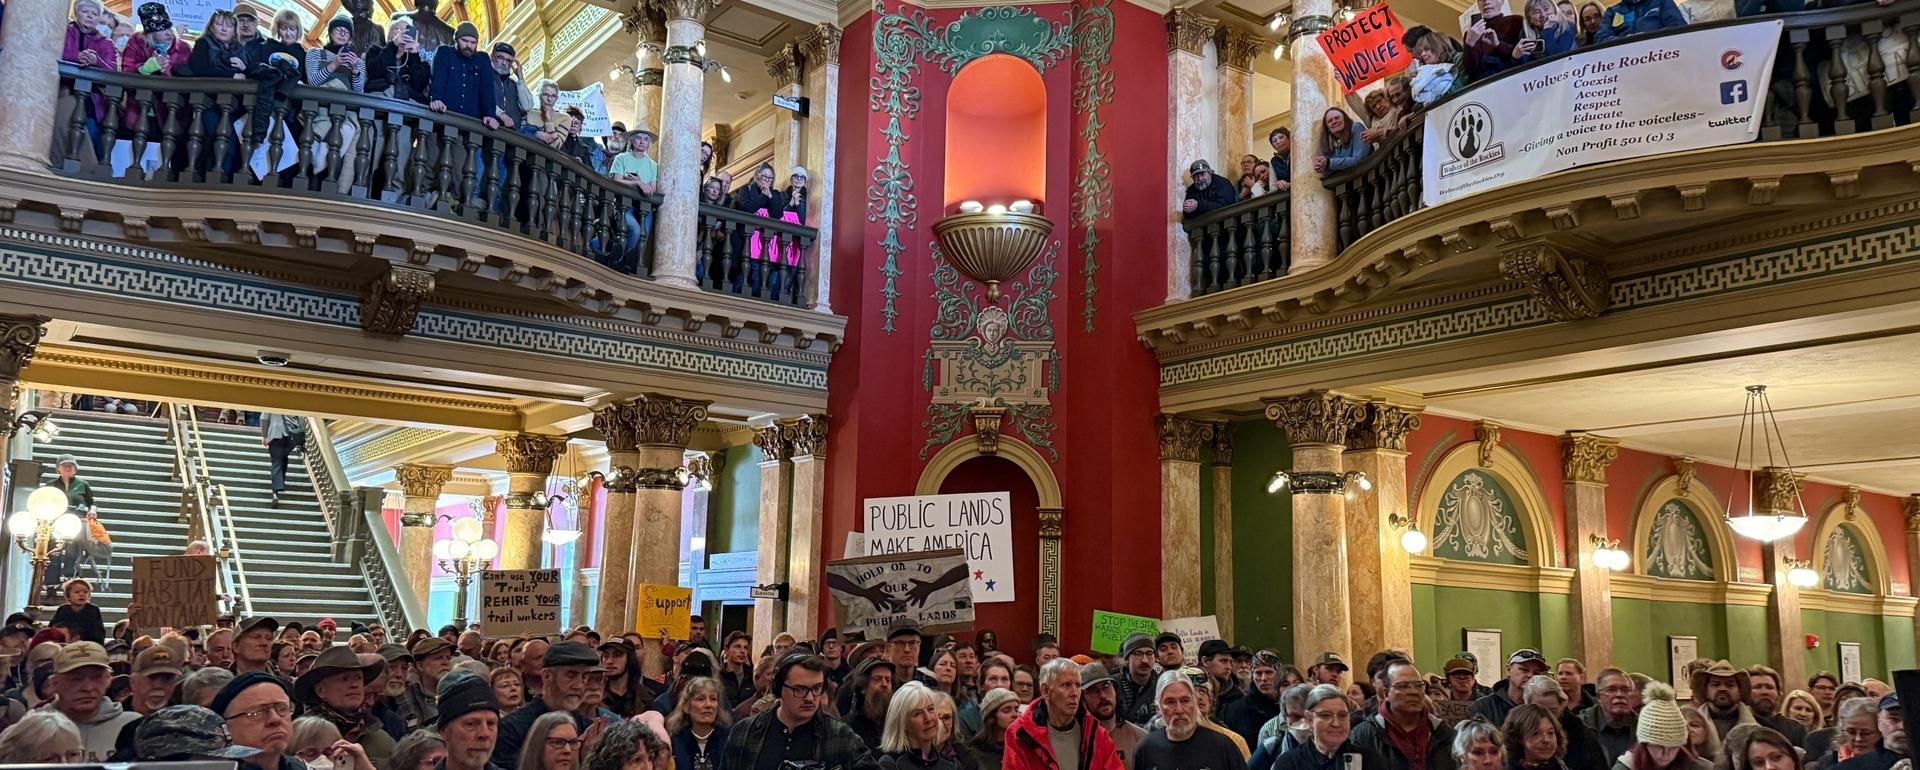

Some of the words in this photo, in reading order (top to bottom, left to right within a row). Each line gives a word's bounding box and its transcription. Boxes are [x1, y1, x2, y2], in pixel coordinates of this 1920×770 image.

[1324, 6, 1392, 54] PROTECT
[1336, 38, 1400, 90] WILDLIFE
[1522, 70, 1569, 94] Wolves
[1572, 63, 1590, 80] of
[1592, 61, 1614, 74] the
[1618, 49, 1680, 68] Rockies
[1573, 74, 1618, 89] Coexist
[1575, 86, 1618, 100] Accept
[1573, 98, 1621, 112] Respect
[1572, 110, 1624, 124] Educate
[1708, 116, 1752, 128] twitter
[1557, 132, 1564, 140] a
[1566, 125, 1597, 138] voice
[1600, 121, 1612, 132] to
[1616, 118, 1636, 129] the
[1556, 145, 1578, 158] Non
[1582, 138, 1617, 152] Profit
[1620, 136, 1642, 147] 501
[1646, 132, 1664, 144] (c)
[1666, 132, 1675, 142] 3
[1444, 164, 1462, 174] Wolves
[1464, 160, 1469, 168] of
[1478, 150, 1500, 162] Rockies
[870, 500, 936, 532] PUBLIC
[948, 498, 1004, 527] LANDS
[870, 536, 916, 557] MAKE
[150, 558, 206, 578] FUND
[530, 570, 558, 582] YOUR
[856, 566, 884, 585] HOLD
[916, 562, 932, 574] TO
[136, 578, 212, 606] HABITAT
[884, 583, 908, 594] OUR
[484, 596, 529, 608] REHIRE
[535, 594, 560, 605] YOUR
[488, 610, 513, 622] trail
[518, 608, 556, 622] workers
[1100, 614, 1126, 626] STOP
[1128, 618, 1138, 628] THE
